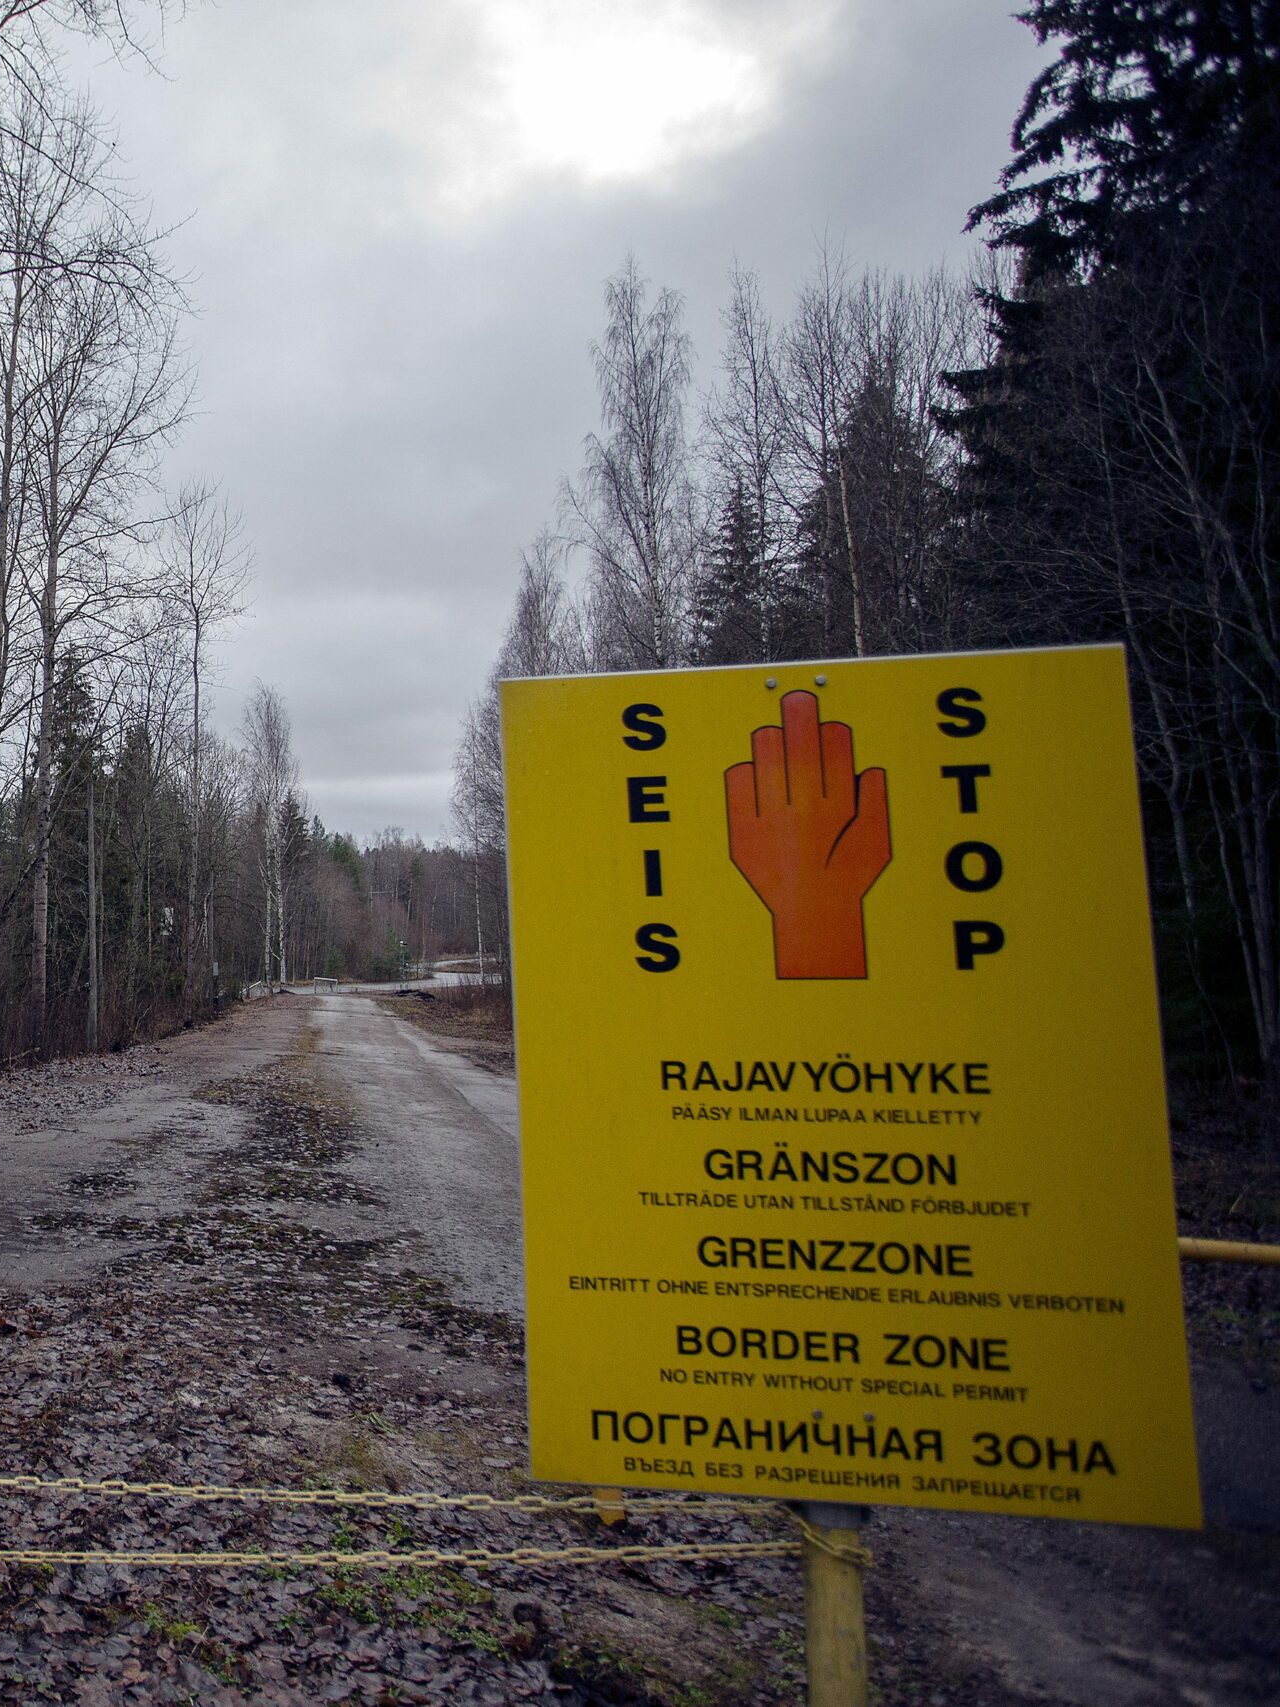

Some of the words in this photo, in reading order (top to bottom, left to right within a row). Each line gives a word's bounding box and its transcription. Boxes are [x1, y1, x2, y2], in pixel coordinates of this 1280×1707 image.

[621, 703, 681, 974] SEIS
[936, 686, 1006, 971] STOP
[660, 1053, 992, 1096] RAJAVYÖHYKE
[672, 1103, 733, 1122] PÄÄSY
[739, 1107, 800, 1122] ILMAN
[803, 1108, 868, 1124] LUPAA
[873, 1109, 982, 1126] KIELLETTY
[703, 1141, 958, 1187] GRÄNSZON
[638, 1190, 739, 1209] TILLTRÄDE
[743, 1194, 796, 1211] UTAN
[799, 1193, 907, 1214] TILLSTÅND
[910, 1194, 1032, 1218] FÖRBJUDET
[697, 1235, 974, 1278] GRENZZONE
[569, 1275, 651, 1293] EINTRITT
[656, 1279, 709, 1296] OHNE
[714, 1281, 883, 1304] ENTSPRECHENDE
[887, 1288, 1003, 1309] ERLAUBNIS
[1008, 1293, 1127, 1316] VERBOTEN
[676, 1325, 861, 1365] BORDER
[883, 1333, 1011, 1373] ZONE
[659, 1368, 689, 1385] NO
[693, 1369, 756, 1388] ENTRY
[762, 1373, 855, 1393] WITHOUT
[860, 1378, 947, 1399] SPECIAL
[952, 1383, 1029, 1404] PERMIT
[591, 1410, 945, 1463] ПОГРАНИЧНАЯ
[972, 1431, 1119, 1477] ЗОНА
[623, 1456, 696, 1479] ВЪЕЗД
[704, 1461, 745, 1480] БЕЗ
[754, 1465, 902, 1490] РАЗРЕШЕНИЯ
[912, 1474, 1083, 1504] ЗАПРЕЩАЕТСЯ
